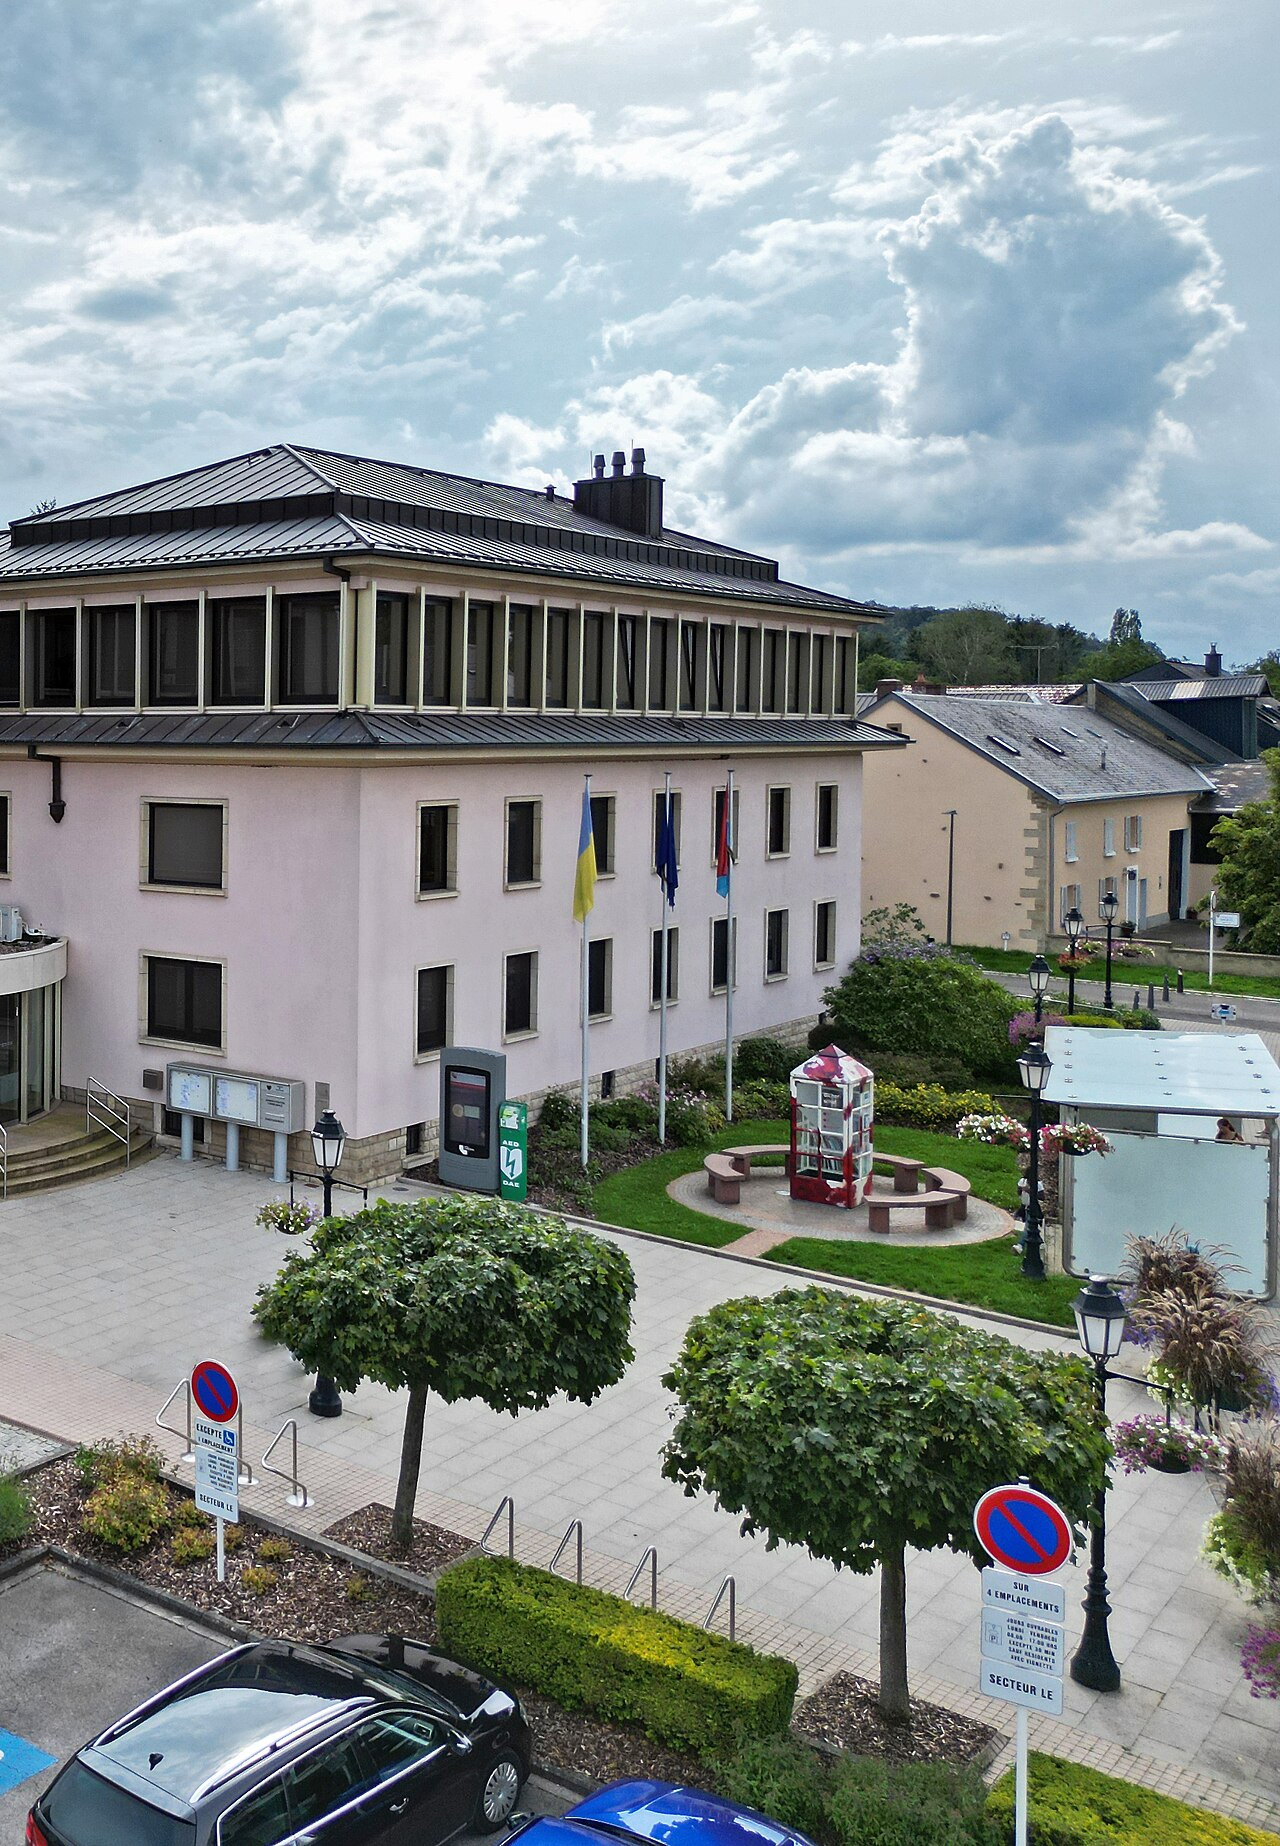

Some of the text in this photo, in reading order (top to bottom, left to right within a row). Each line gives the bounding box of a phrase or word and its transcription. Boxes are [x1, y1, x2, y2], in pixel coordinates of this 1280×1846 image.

[502, 1139, 519, 1147] AED
[502, 1179, 519, 1187] DAE
[196, 1423, 222, 1439] EXCEPTE
[201, 1438, 232, 1453] EMPLACEMENT
[199, 1493, 233, 1512] SECTEUR LE
[1013, 1581, 1029, 1592] SUR
[986, 1588, 1059, 1613] 4 EMPLACEMENTS
[1006, 1617, 1024, 1626] JOURS
[1008, 1639, 1032, 1650] EXCEPTE
[1010, 1654, 1024, 1662] AVEC
[988, 1673, 1053, 1700] SECTEUR LE
